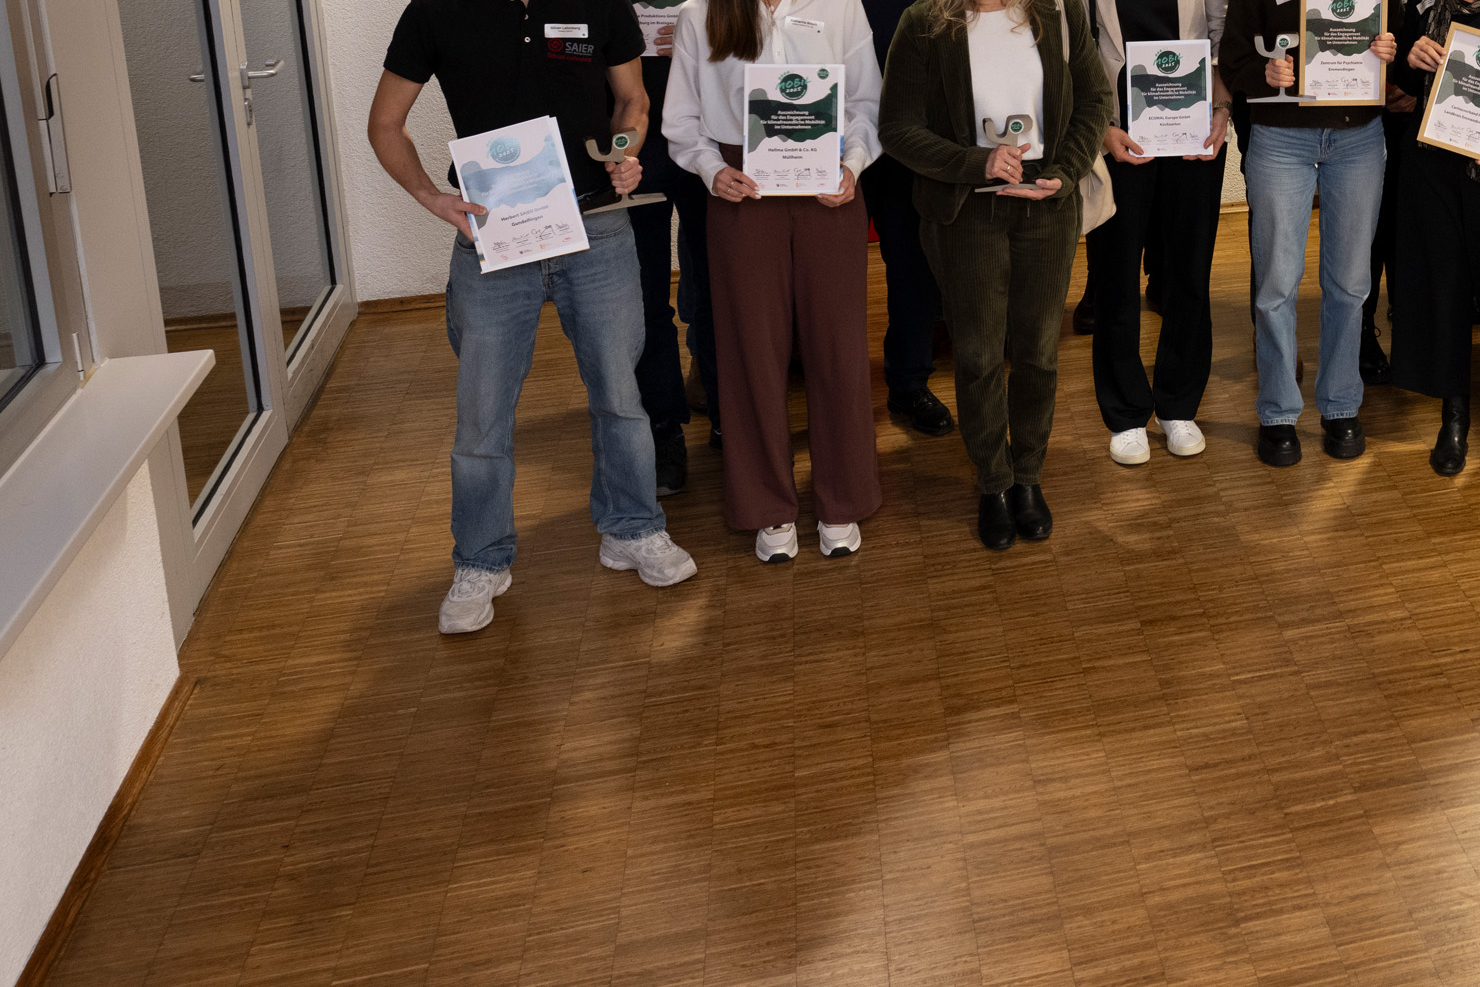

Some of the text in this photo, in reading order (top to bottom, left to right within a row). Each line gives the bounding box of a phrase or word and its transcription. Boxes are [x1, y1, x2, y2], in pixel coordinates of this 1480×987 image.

[565, 42, 595, 54] SAIER
[1153, 53, 1183, 66] MOBIL
[775, 77, 811, 90] MOBIL
